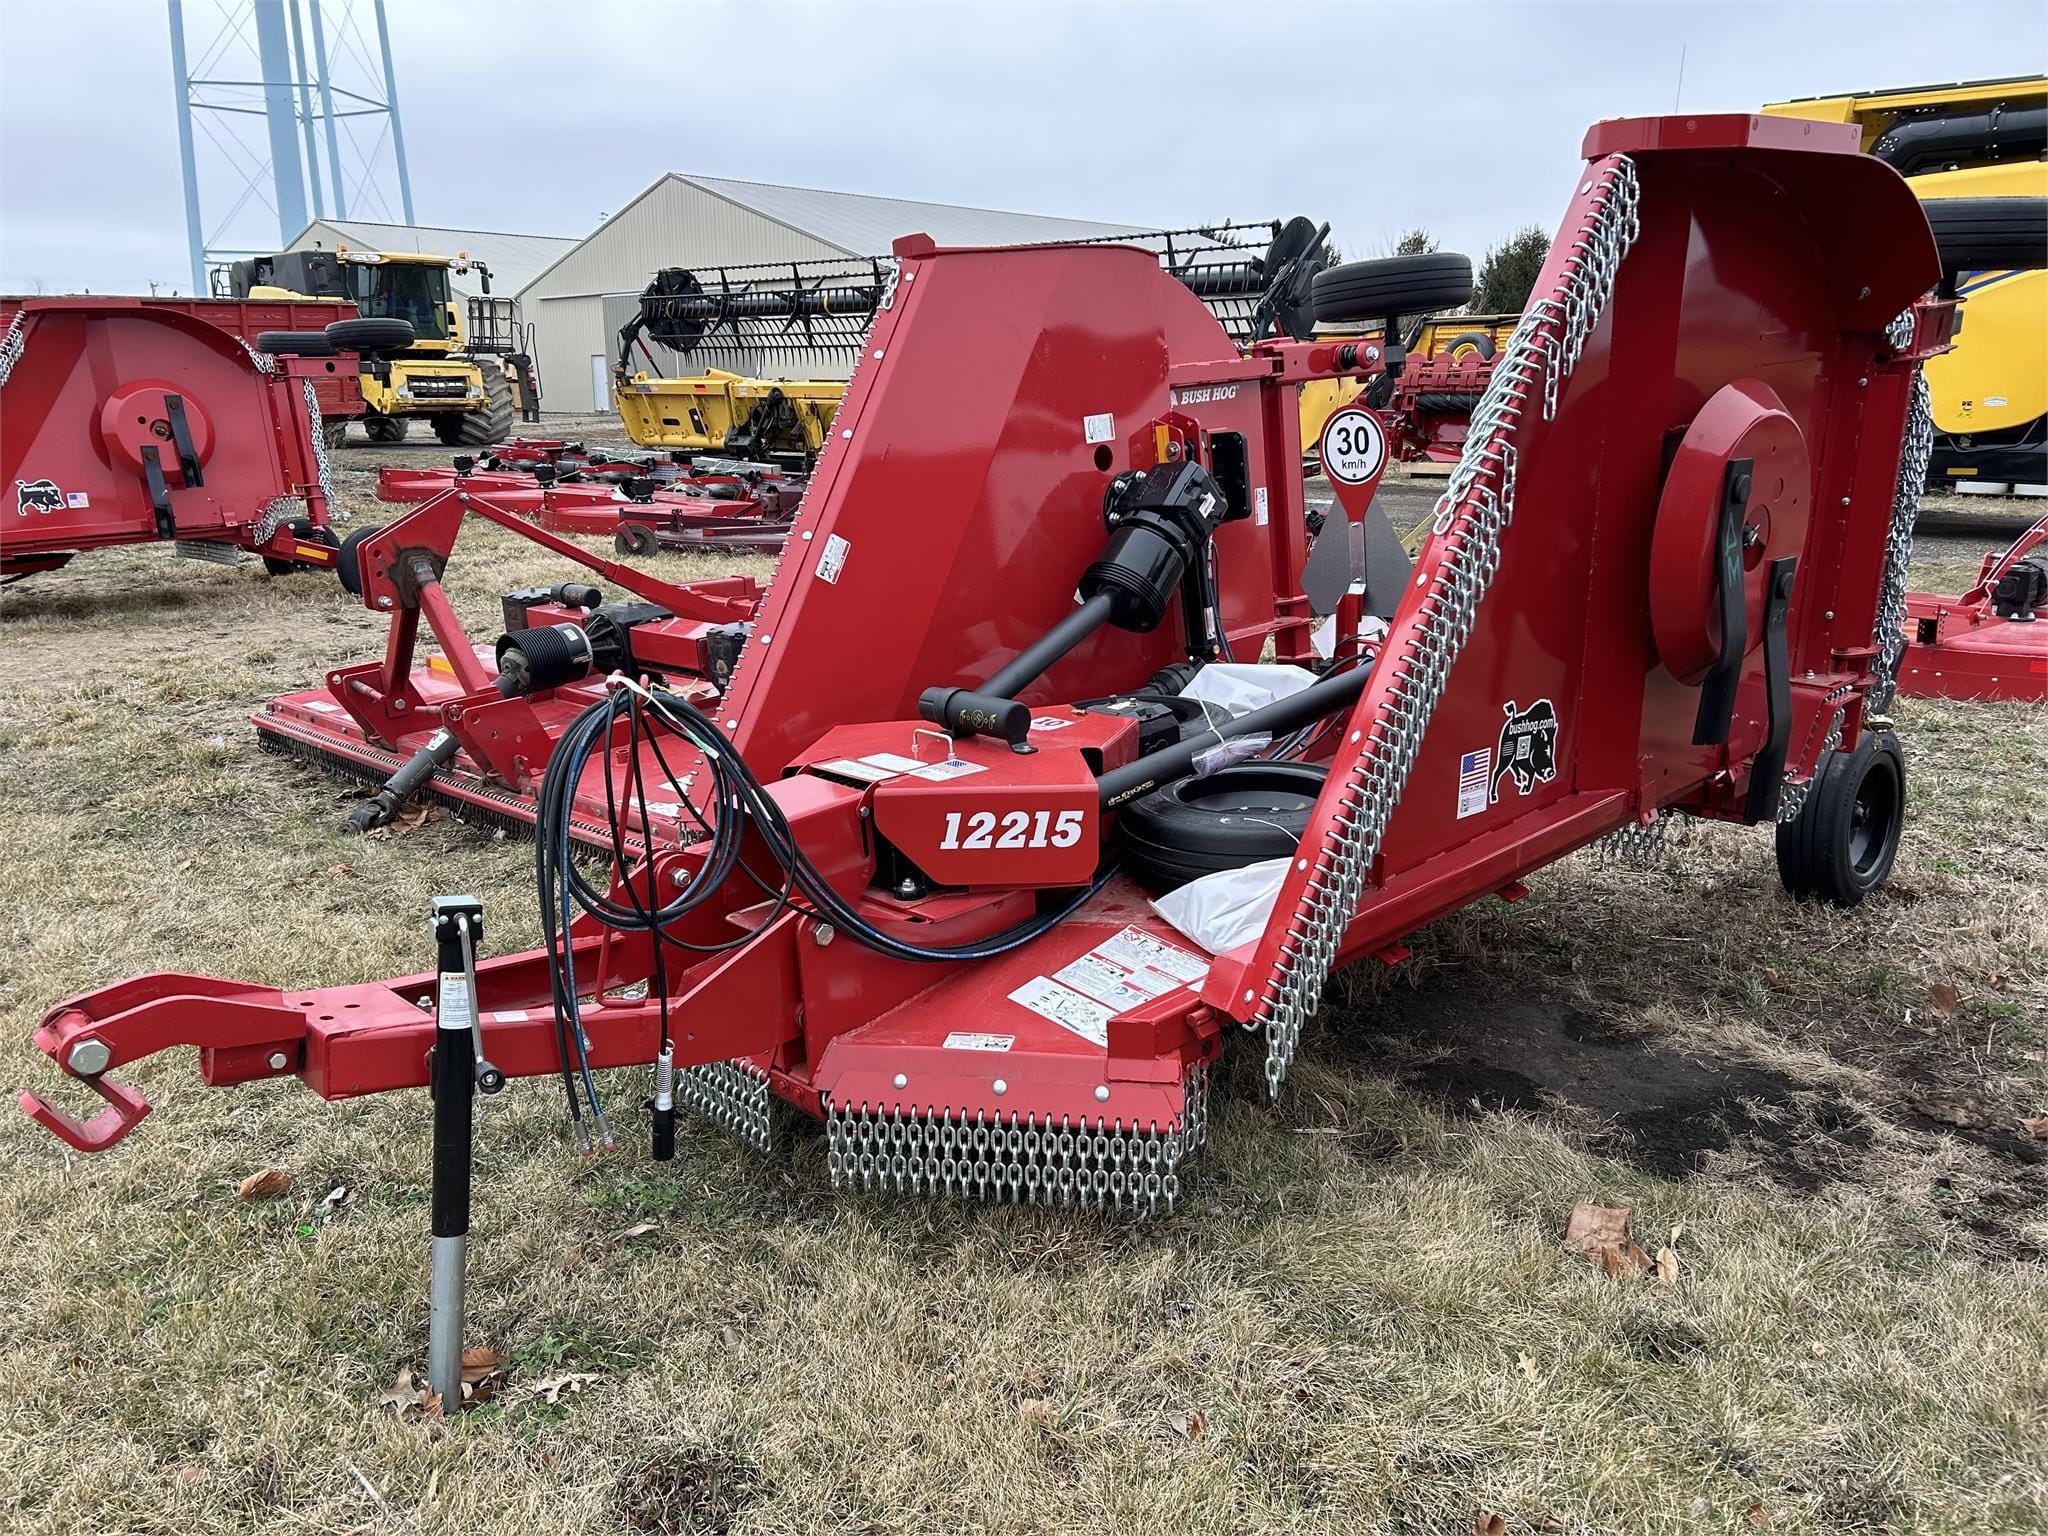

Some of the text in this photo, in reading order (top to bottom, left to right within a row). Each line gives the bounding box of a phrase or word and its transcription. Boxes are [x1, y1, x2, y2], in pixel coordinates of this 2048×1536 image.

[1181, 388, 1211, 405] BUSH
[1337, 426, 1369, 455] 30
[1342, 459, 1366, 469] km/h
[1509, 719, 1553, 735] bushhog.com
[939, 810, 1085, 850] 12215
